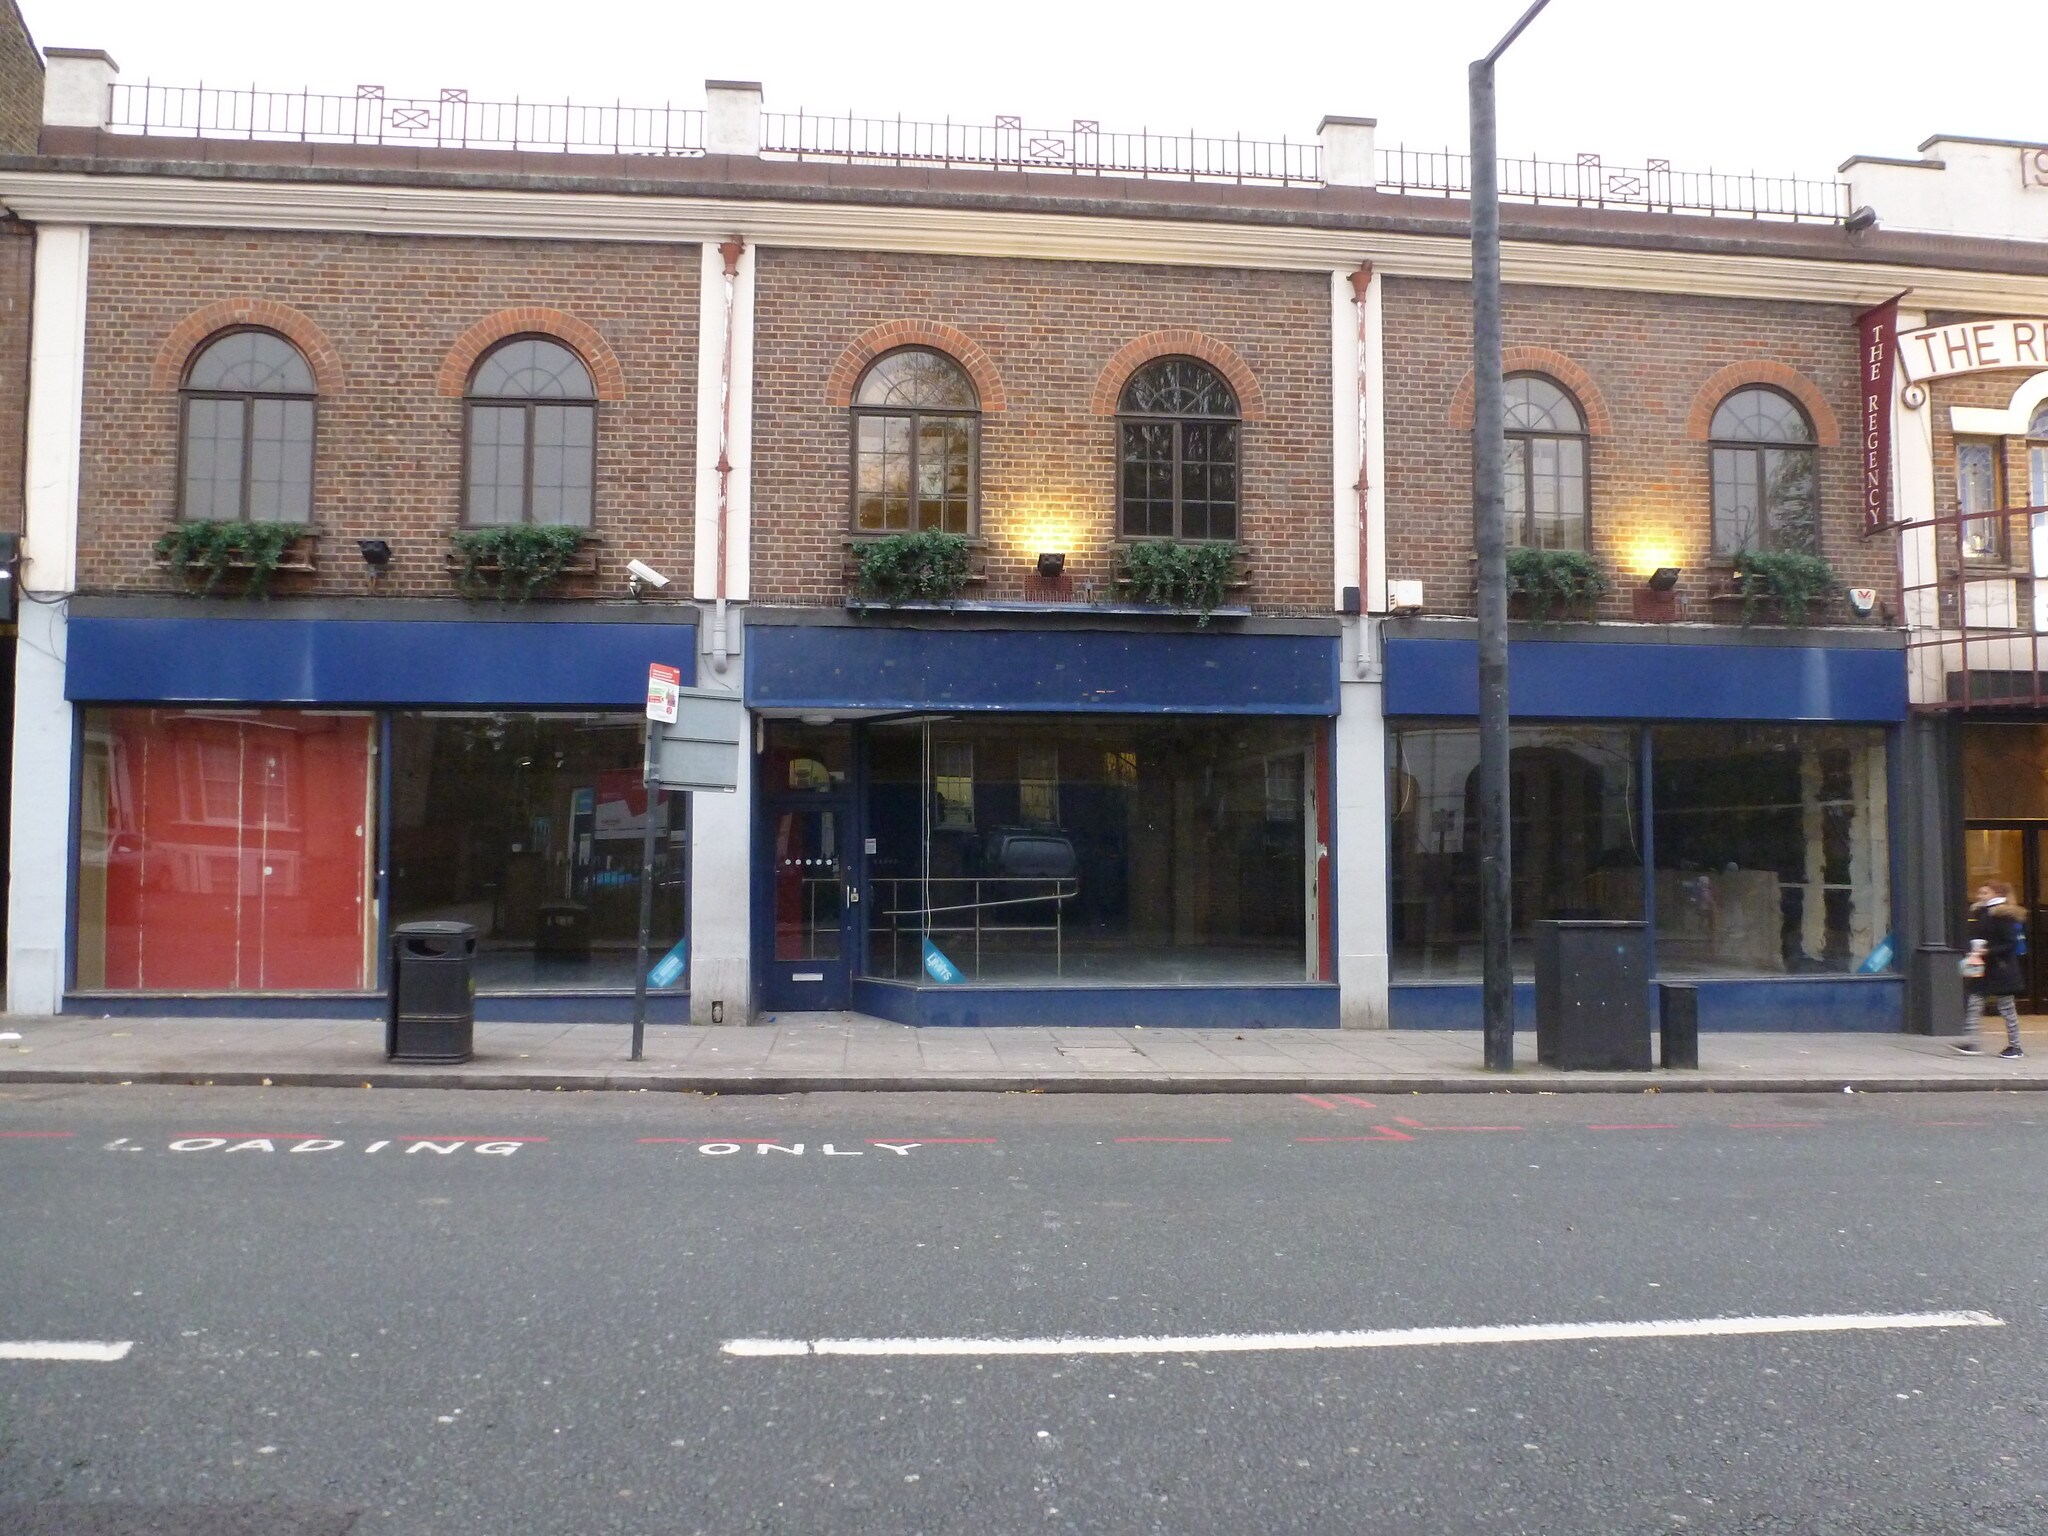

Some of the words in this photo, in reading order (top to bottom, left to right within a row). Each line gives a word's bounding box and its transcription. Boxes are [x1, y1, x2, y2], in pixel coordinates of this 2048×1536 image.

[1868, 324, 1884, 382] THE
[1915, 325, 2001, 373] THE
[2013, 322, 2048, 362] R
[1867, 394, 1880, 525] REGENCY
[102, 1137, 525, 1157] LOADING
[698, 1142, 922, 1156] ONLY
